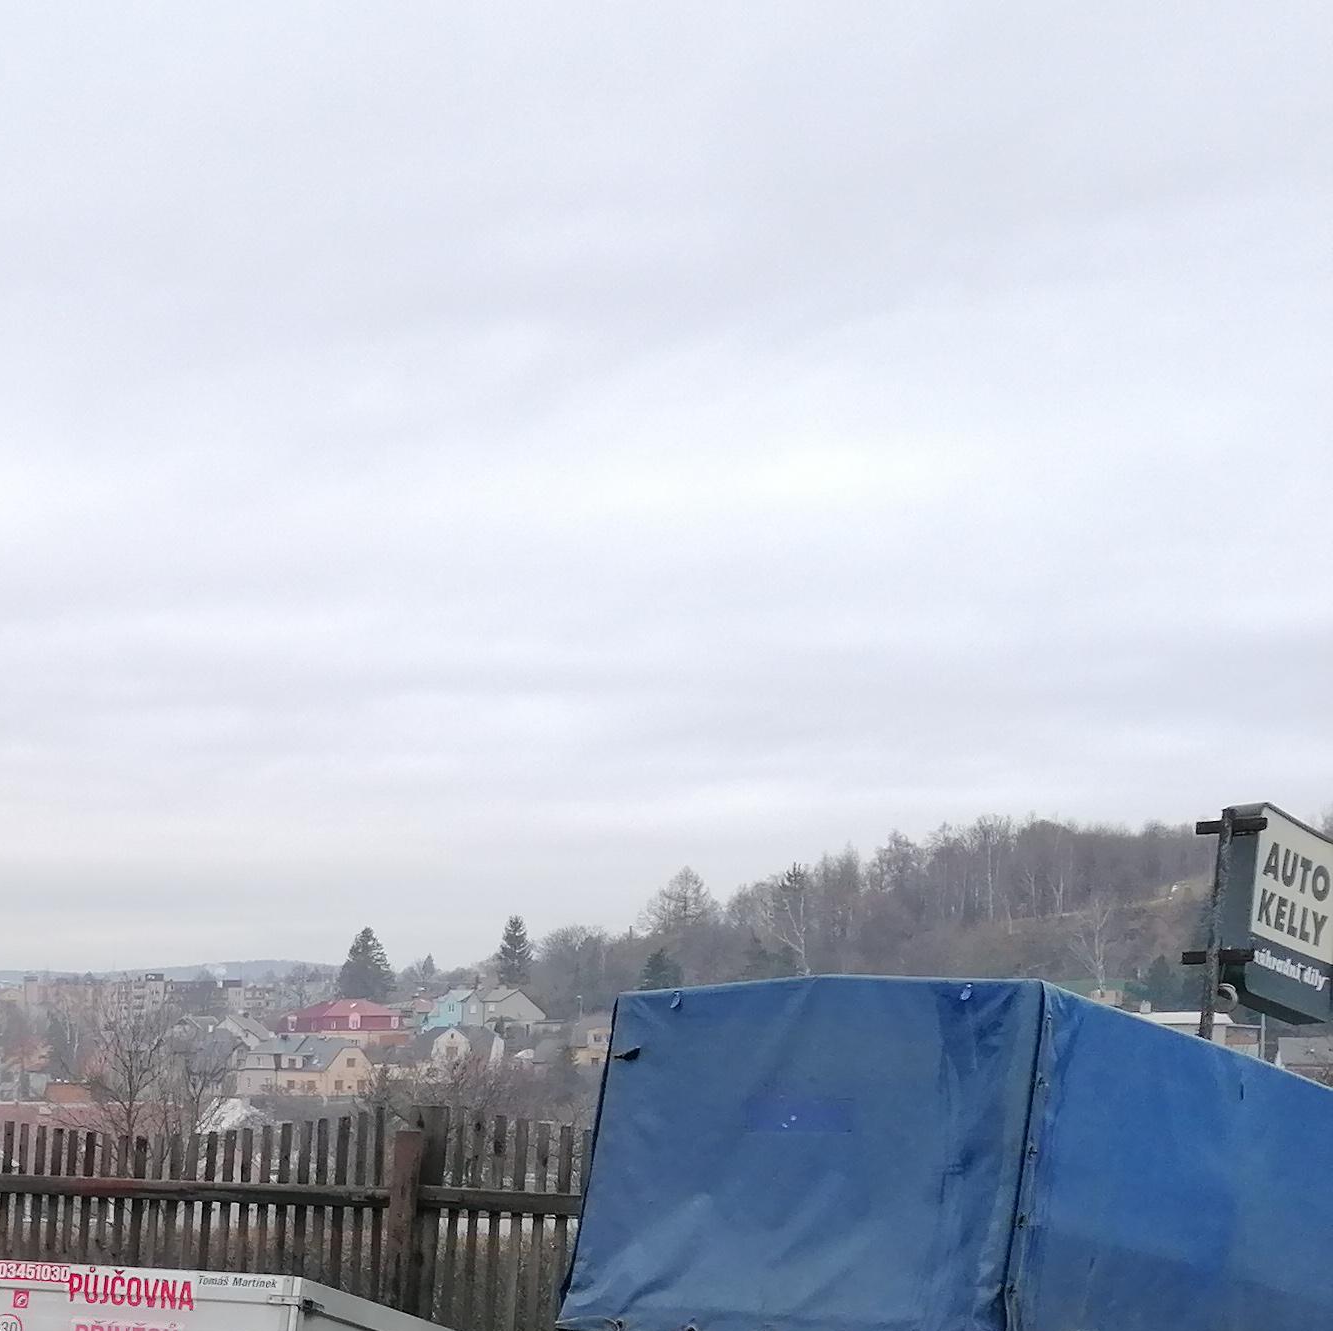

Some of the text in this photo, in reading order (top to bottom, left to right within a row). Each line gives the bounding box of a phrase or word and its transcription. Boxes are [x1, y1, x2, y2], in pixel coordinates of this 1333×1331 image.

[1262, 841, 1331, 902] AUTO
[1257, 887, 1329, 947] KELLY
[68, 1267, 194, 1311] PŮJČOVNA
[198, 1275, 229, 1286] Tomáš
